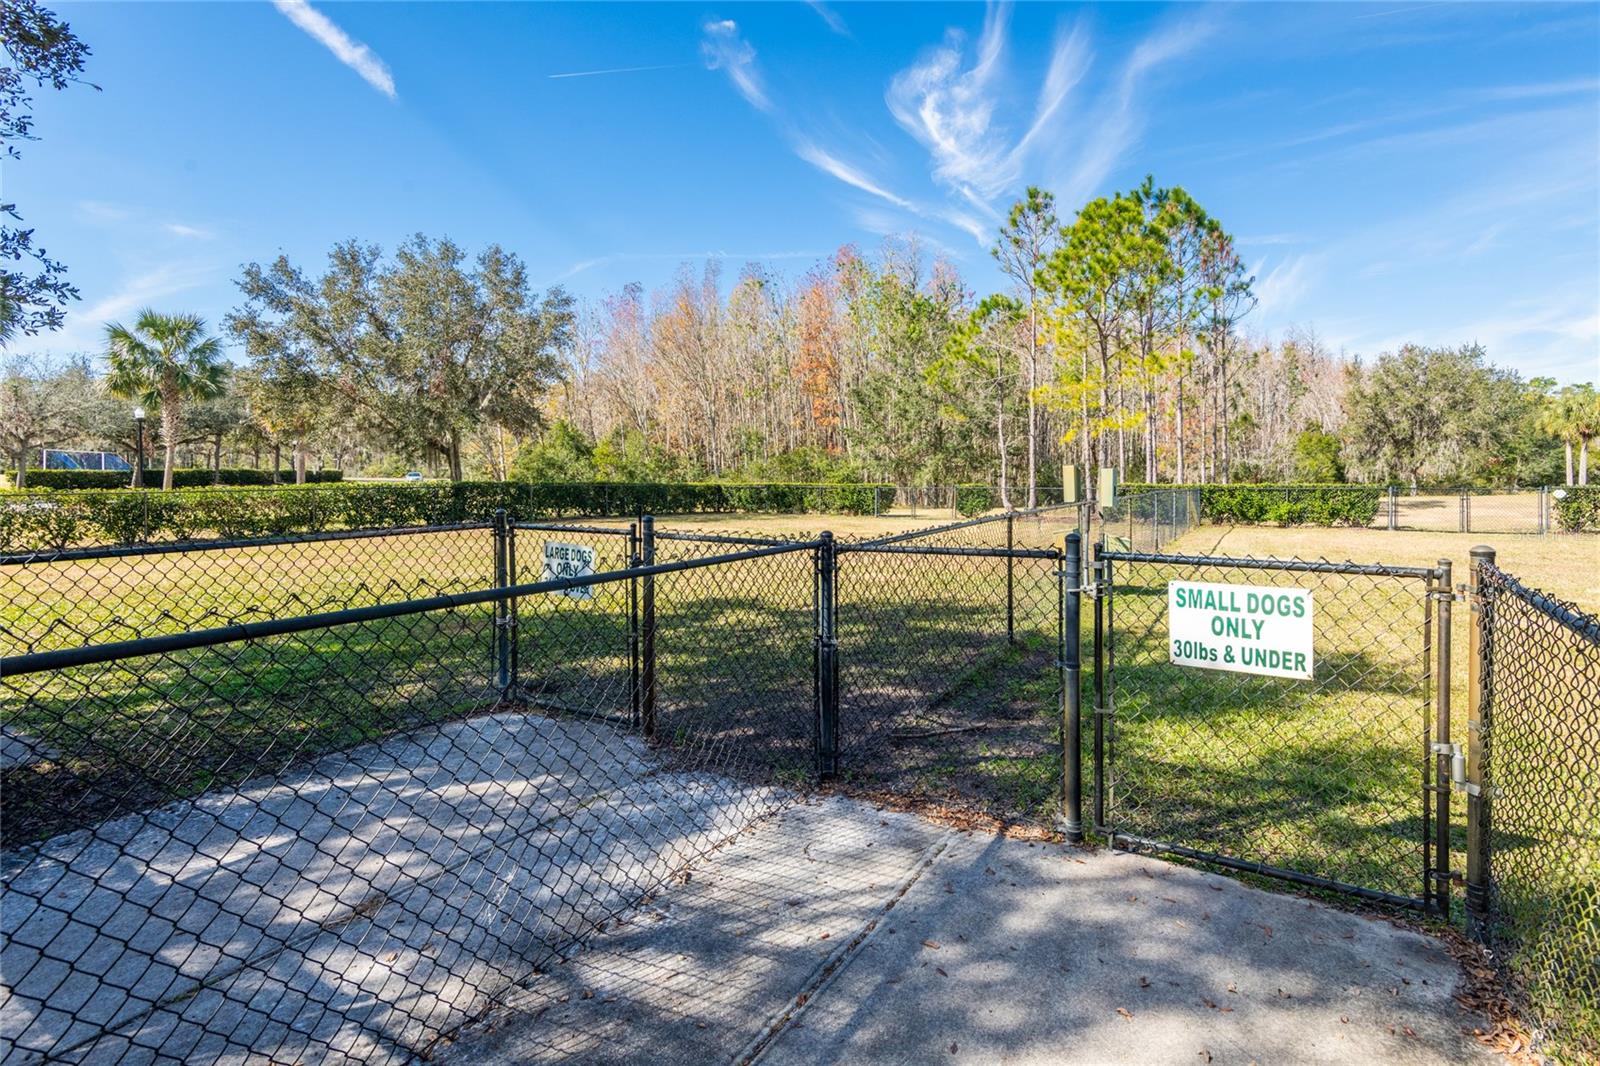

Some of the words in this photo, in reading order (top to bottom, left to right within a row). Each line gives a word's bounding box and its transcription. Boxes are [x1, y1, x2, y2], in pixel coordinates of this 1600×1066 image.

[545, 546, 569, 560] LARGE
[571, 549, 592, 563] DOGS
[556, 562, 579, 577] ONLY
[1176, 587, 1241, 612] SMALL
[1247, 593, 1305, 618] DOGS
[1211, 616, 1265, 640] ONLY
[1173, 639, 1218, 662] 30lbs
[1223, 645, 1236, 664] &
[1241, 647, 1307, 672] UNDER
